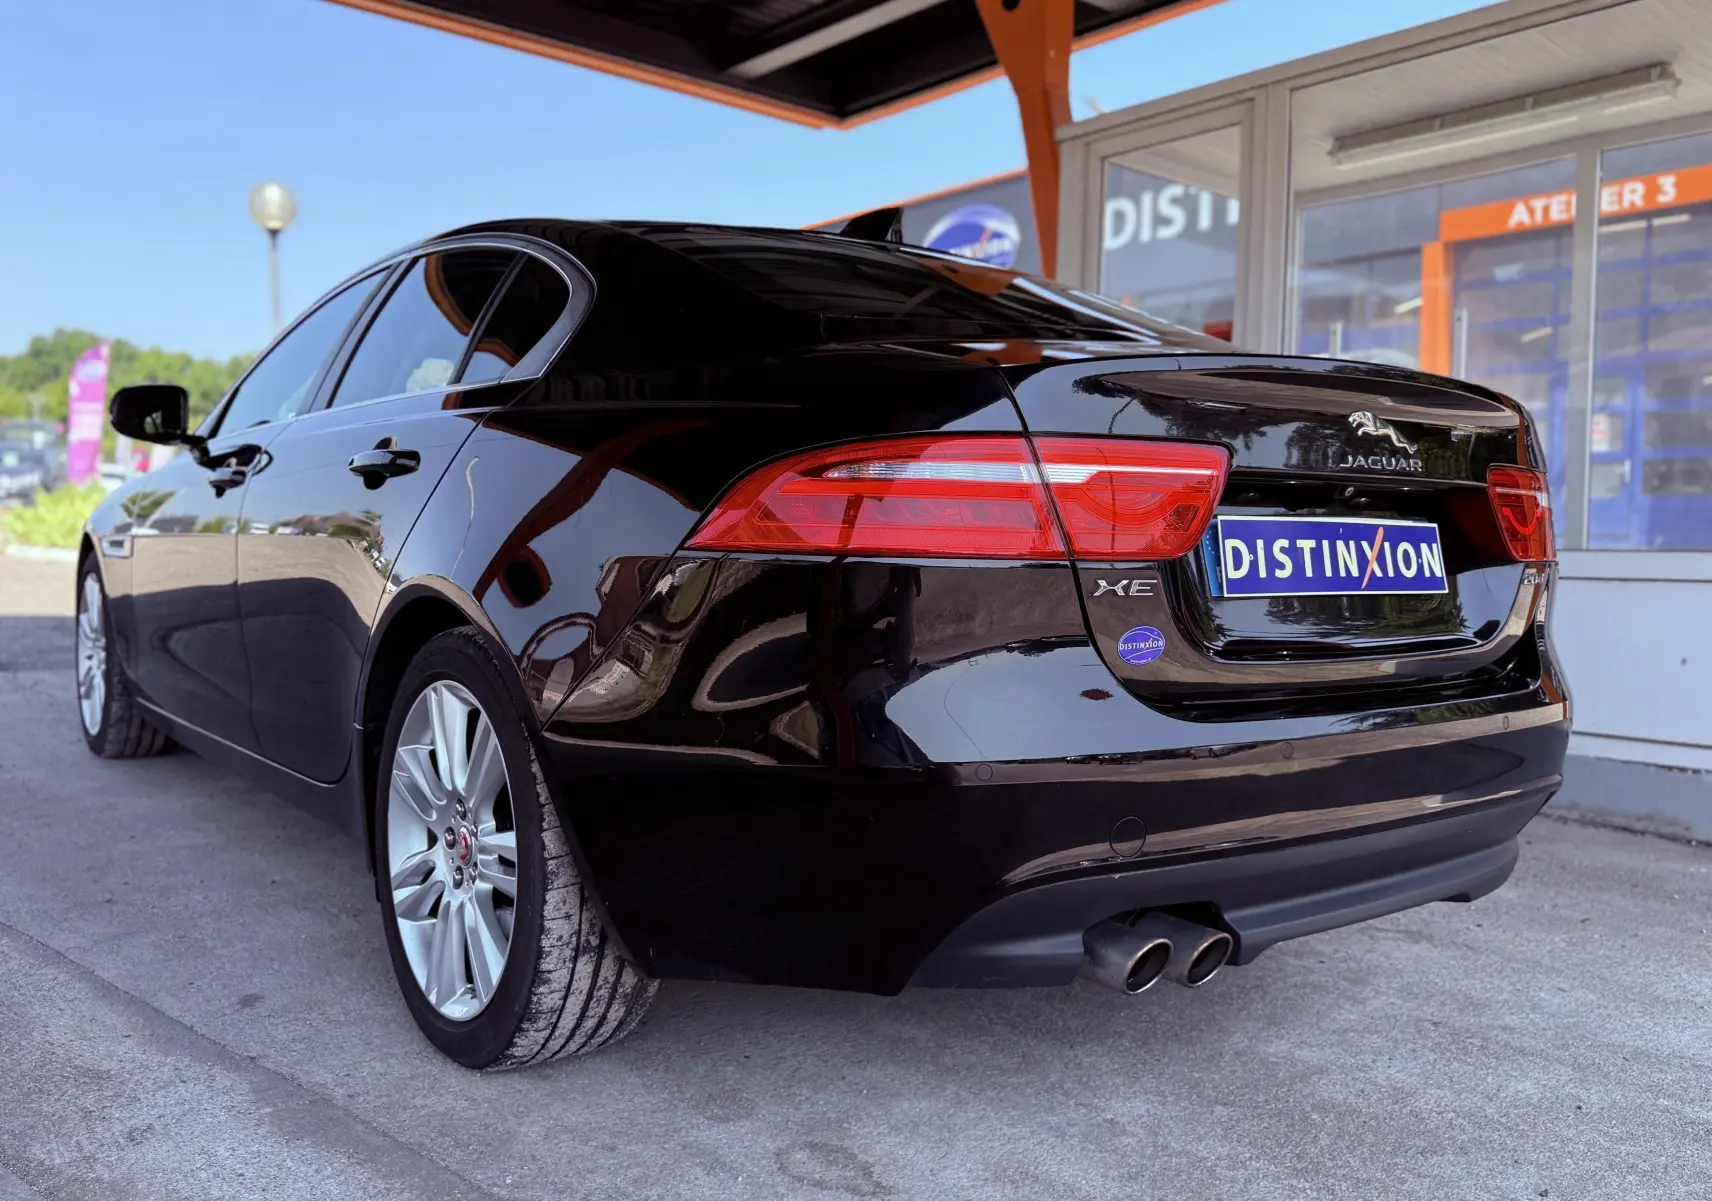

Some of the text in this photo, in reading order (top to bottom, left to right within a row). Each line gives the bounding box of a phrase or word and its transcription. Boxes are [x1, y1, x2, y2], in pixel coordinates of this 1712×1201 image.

[1508, 174, 1677, 229] ATEER 3
[1340, 454, 1422, 471] JAGUAR
[1224, 527, 1443, 589] DISTINXION
[1093, 579, 1158, 596] XE
[1119, 638, 1164, 651] DISTINXION
